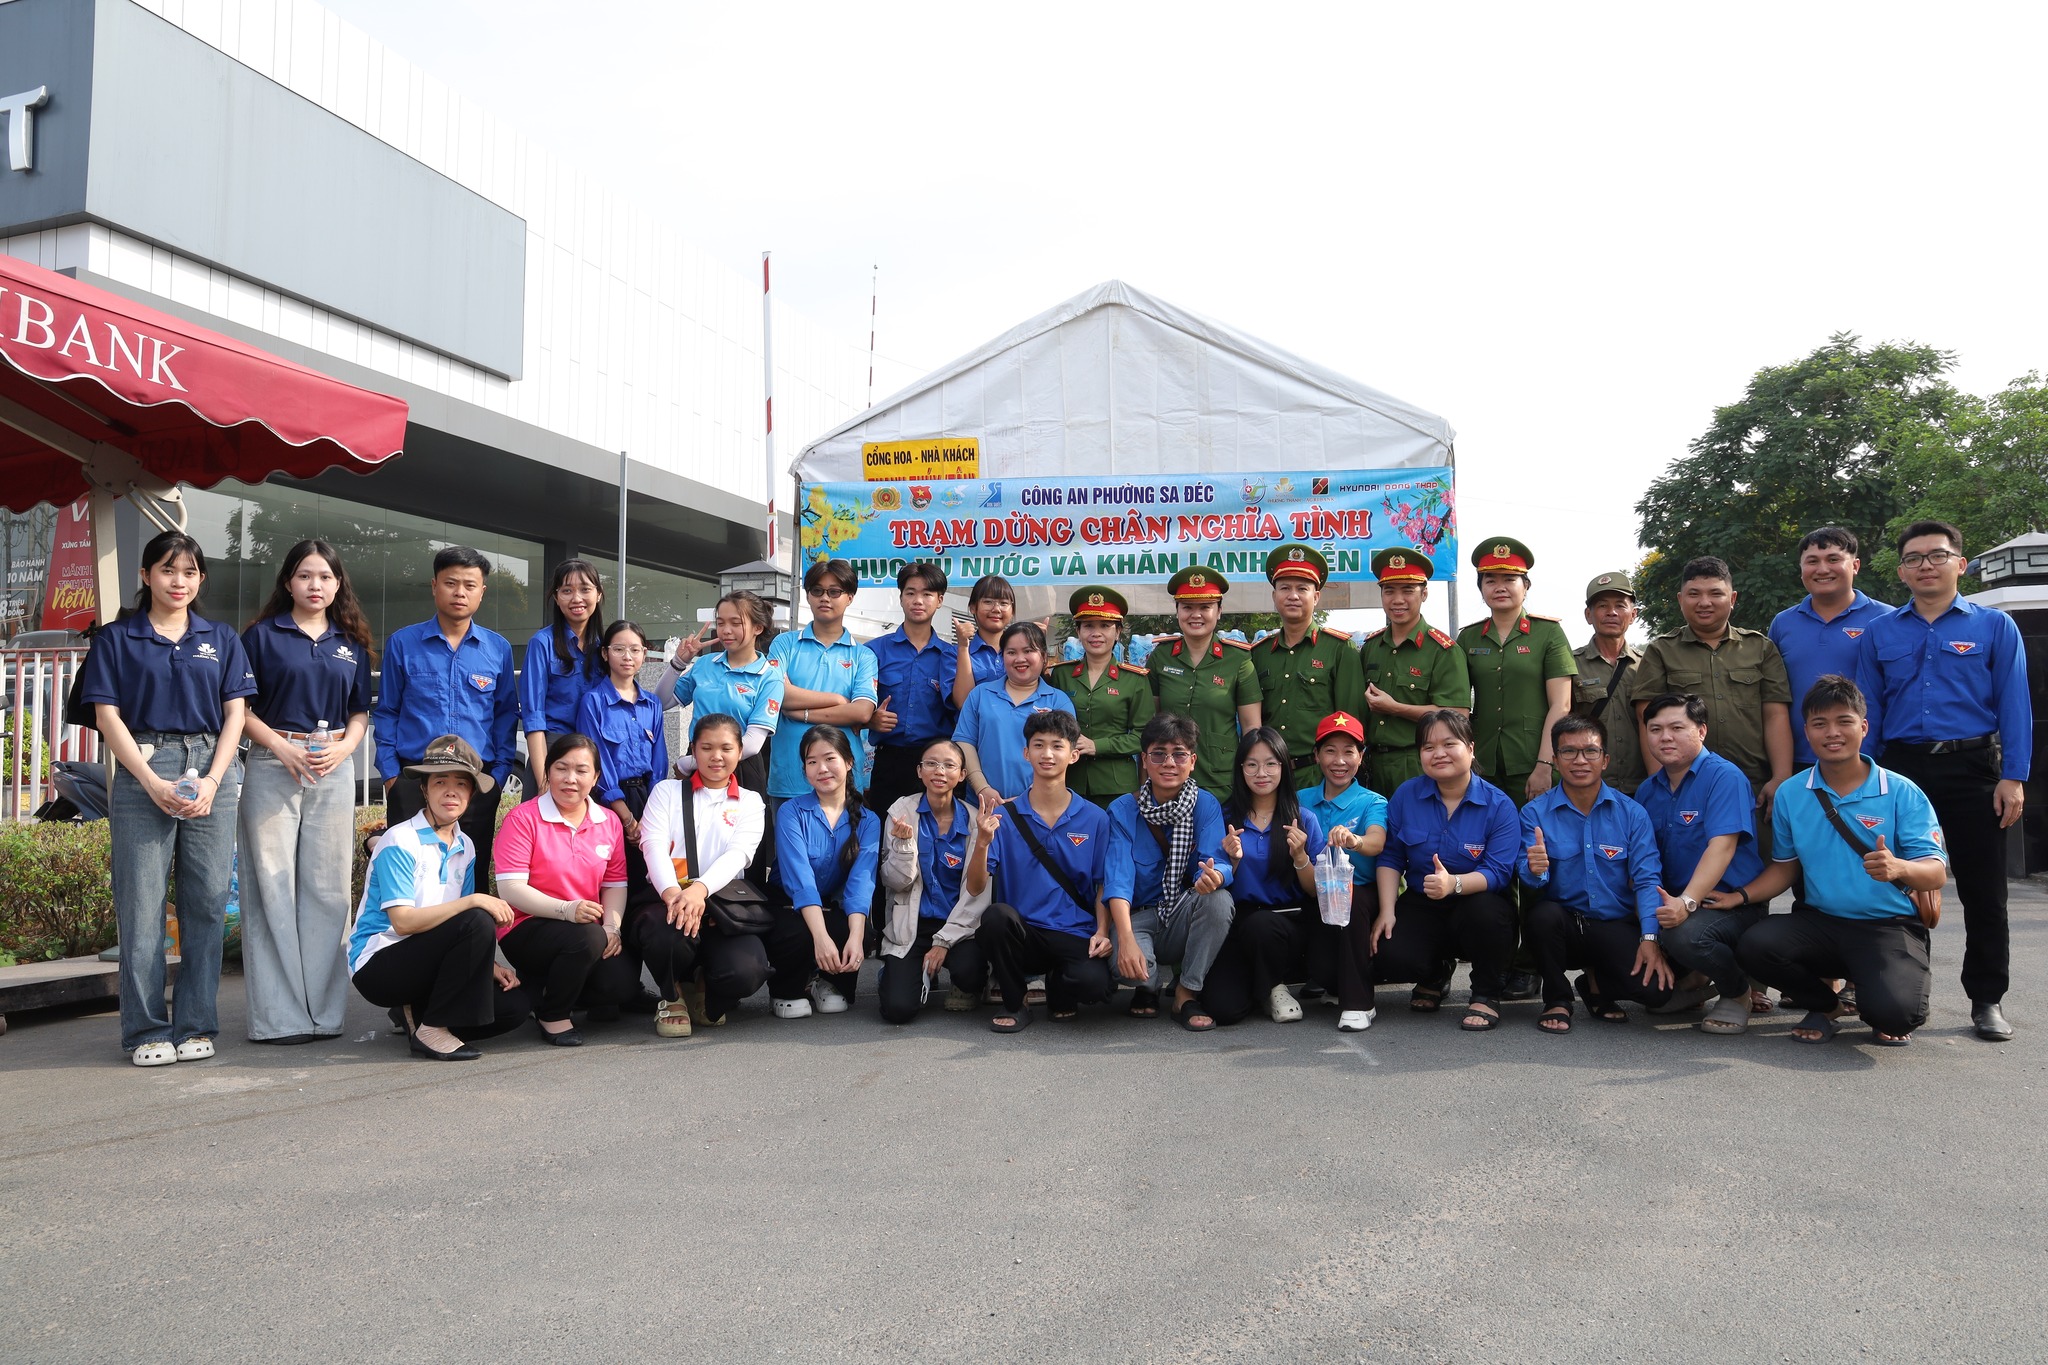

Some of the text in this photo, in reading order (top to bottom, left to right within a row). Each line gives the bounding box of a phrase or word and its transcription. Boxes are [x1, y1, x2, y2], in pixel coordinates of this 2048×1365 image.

[0, 286, 188, 392] BANK
[866, 446, 891, 466] CỔNG
[894, 450, 912, 465] HOA
[921, 446, 940, 463] NHÀ
[943, 445, 975, 462] KHÁCH
[1021, 482, 1214, 505] CÔNG AN PHƯỜNG SA ĐÉC
[1339, 484, 1379, 492] HYUNDAI
[889, 504, 1373, 554] TRẠM DỪNG CHÂN NGHĨA TÌNH
[7, 568, 44, 584] 10 NĂM
[848, 557, 906, 584] HỤC
[960, 552, 1040, 577] NƯỚC
[1051, 552, 1088, 576] VÀ
[1097, 549, 1179, 575] KHĂN
